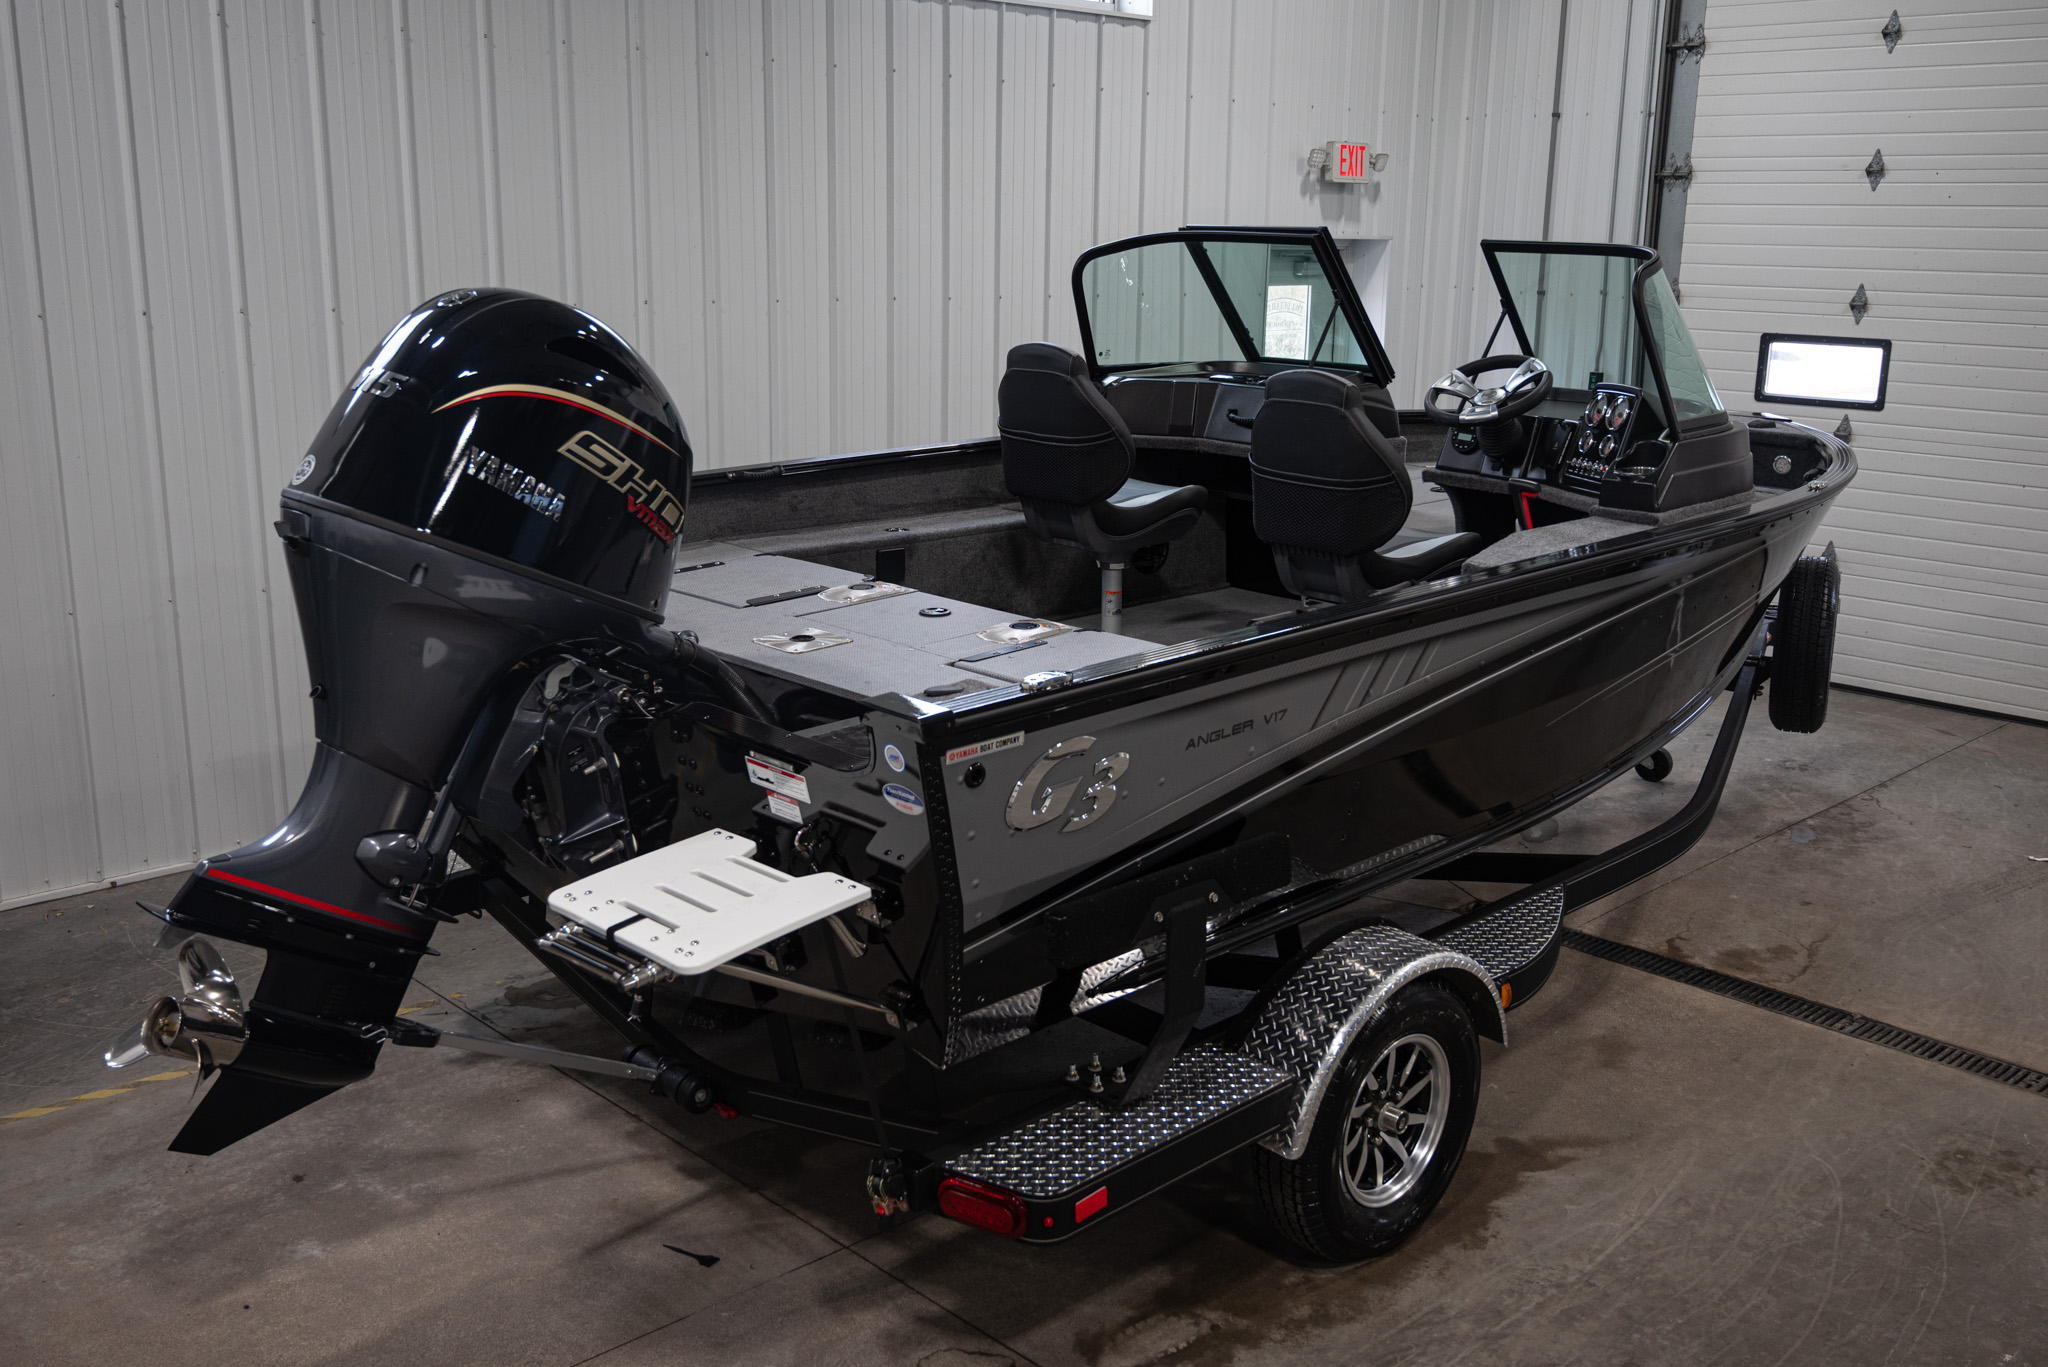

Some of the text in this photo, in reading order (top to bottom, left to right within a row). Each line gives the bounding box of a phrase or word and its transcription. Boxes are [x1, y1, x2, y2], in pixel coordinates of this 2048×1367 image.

[1340, 144, 1366, 177] EXIT
[466, 445, 566, 523] YAMAHA
[956, 735, 1020, 760] YAMAHA BOAT COMPANY
[1185, 708, 1288, 751] ANGLER V17
[1005, 735, 1130, 833] G3
